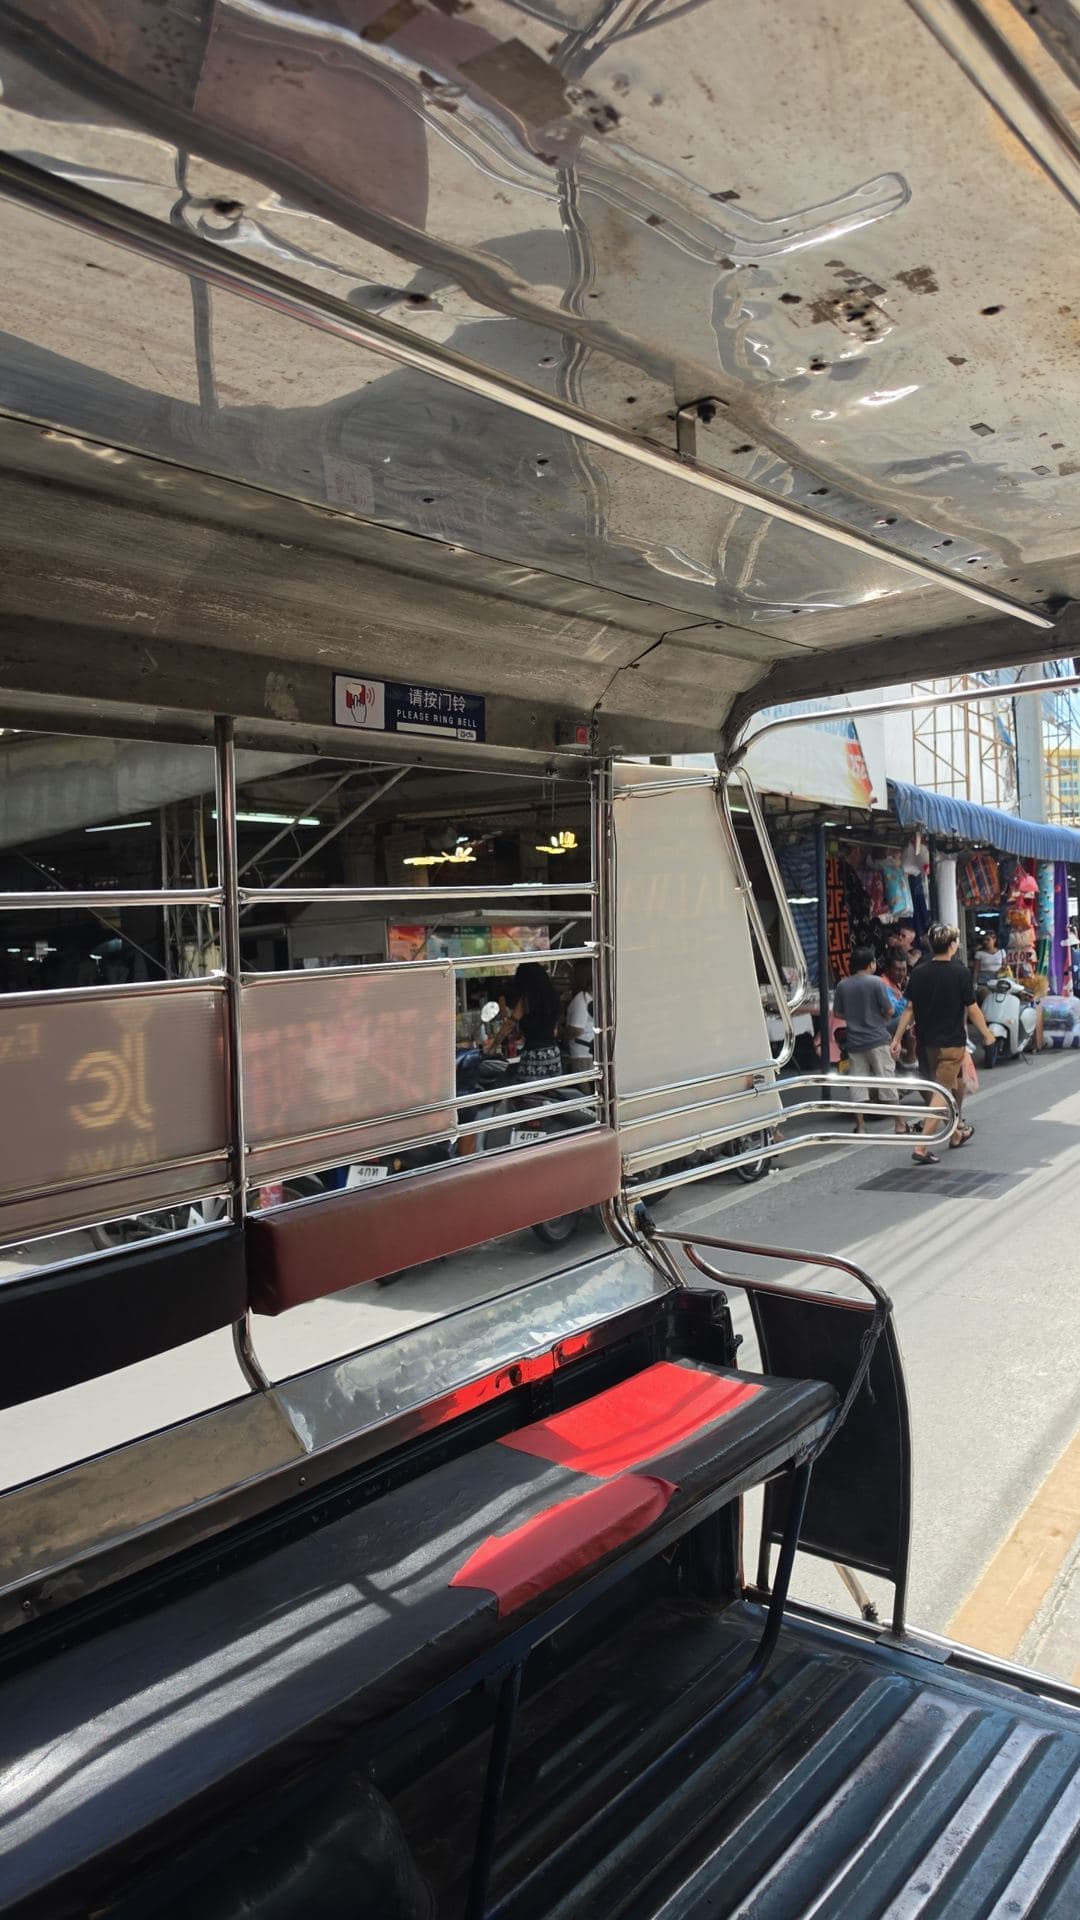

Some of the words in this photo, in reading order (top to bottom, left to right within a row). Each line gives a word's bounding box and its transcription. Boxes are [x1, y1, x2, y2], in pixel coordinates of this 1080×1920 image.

[409, 688, 466, 713] 请按门铃
[397, 709, 429, 722] PLEASE
[433, 714, 453, 725] RING
[457, 717, 477, 728] BELL
